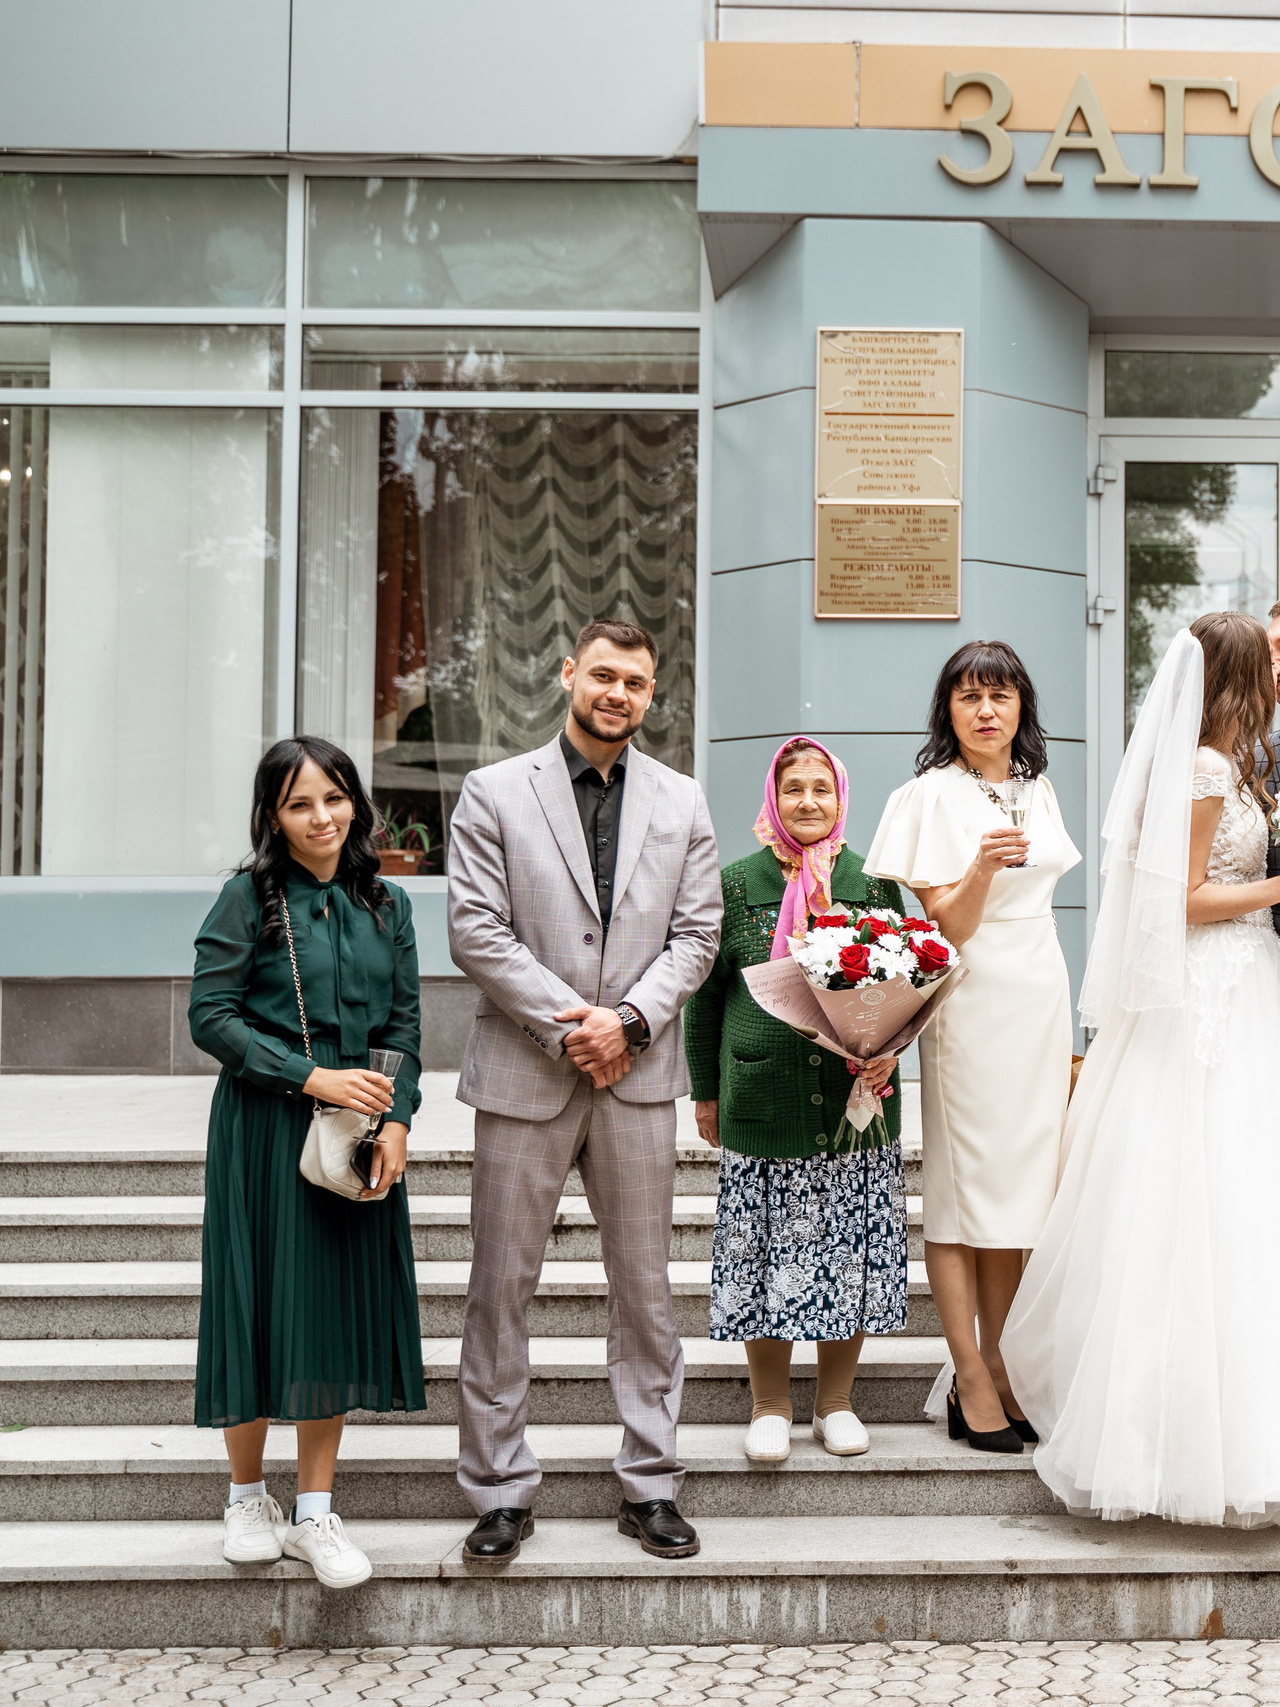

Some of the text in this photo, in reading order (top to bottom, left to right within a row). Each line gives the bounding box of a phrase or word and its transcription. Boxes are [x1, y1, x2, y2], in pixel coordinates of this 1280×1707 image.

[828, 422, 910, 432] Государственный
[826, 434, 952, 444] Республики Башкортостан
[861, 458, 917, 467] Отдел ЗАГС
[862, 472, 916, 480] Советского
[857, 484, 891, 492] района
[902, 484, 921, 494] Уфа
[843, 563, 885, 572] РЕЖИМ
